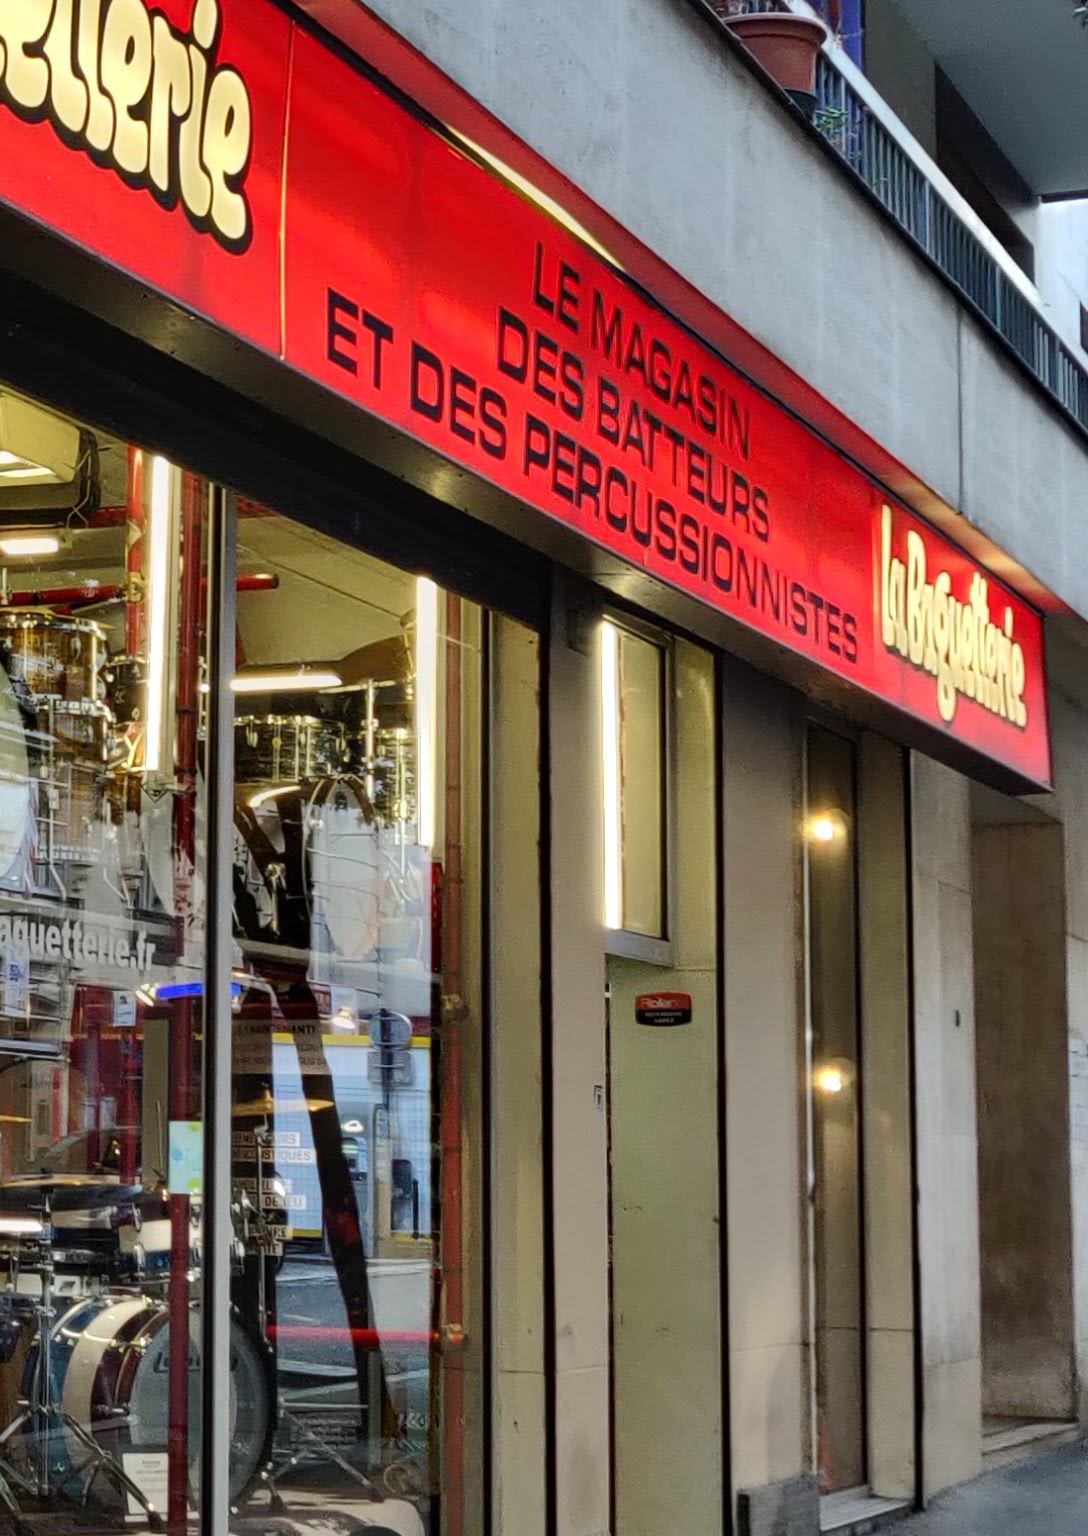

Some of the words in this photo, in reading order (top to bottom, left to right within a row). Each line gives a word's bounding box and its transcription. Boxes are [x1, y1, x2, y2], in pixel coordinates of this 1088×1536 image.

[497, 307, 584, 421] DES
[599, 377, 770, 544] BATTEURS
[533, 241, 580, 333] LE
[592, 291, 751, 459] MAGASIN
[327, 287, 394, 389] ET
[410, 344, 508, 461] DES
[524, 413, 858, 664] PERCUSSIONNISTES
[907, 529, 1028, 729] Baguetterie
